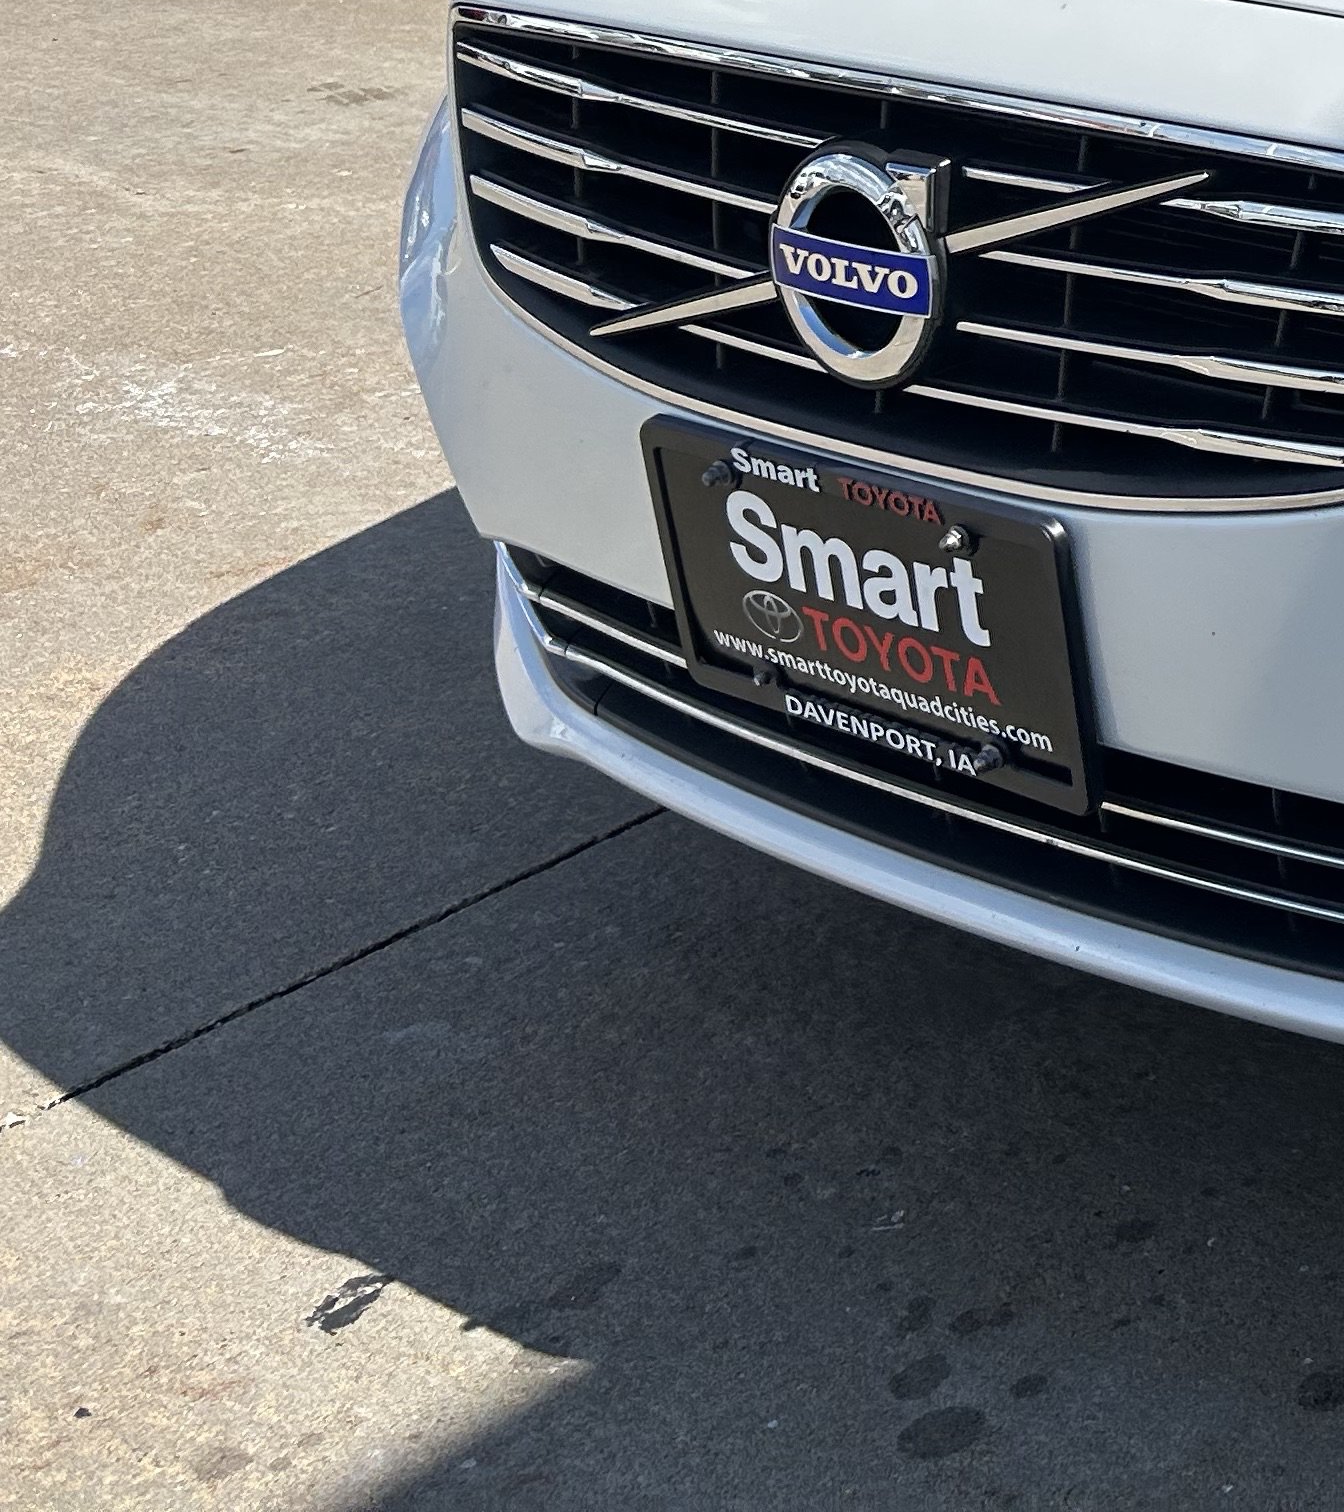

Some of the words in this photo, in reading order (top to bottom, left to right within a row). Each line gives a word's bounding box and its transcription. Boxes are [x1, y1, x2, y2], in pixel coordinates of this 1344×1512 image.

[779, 243, 919, 299] VOLVO
[730, 447, 821, 493] Smart
[836, 477, 945, 526] TOYOTA
[725, 490, 991, 648] Smart
[713, 629, 1054, 753] www.smarttoyotaquadcities.com
[802, 606, 1003, 707] TOYOTA
[785, 694, 942, 767] DAVENPORT,
[949, 749, 978, 777] IA
